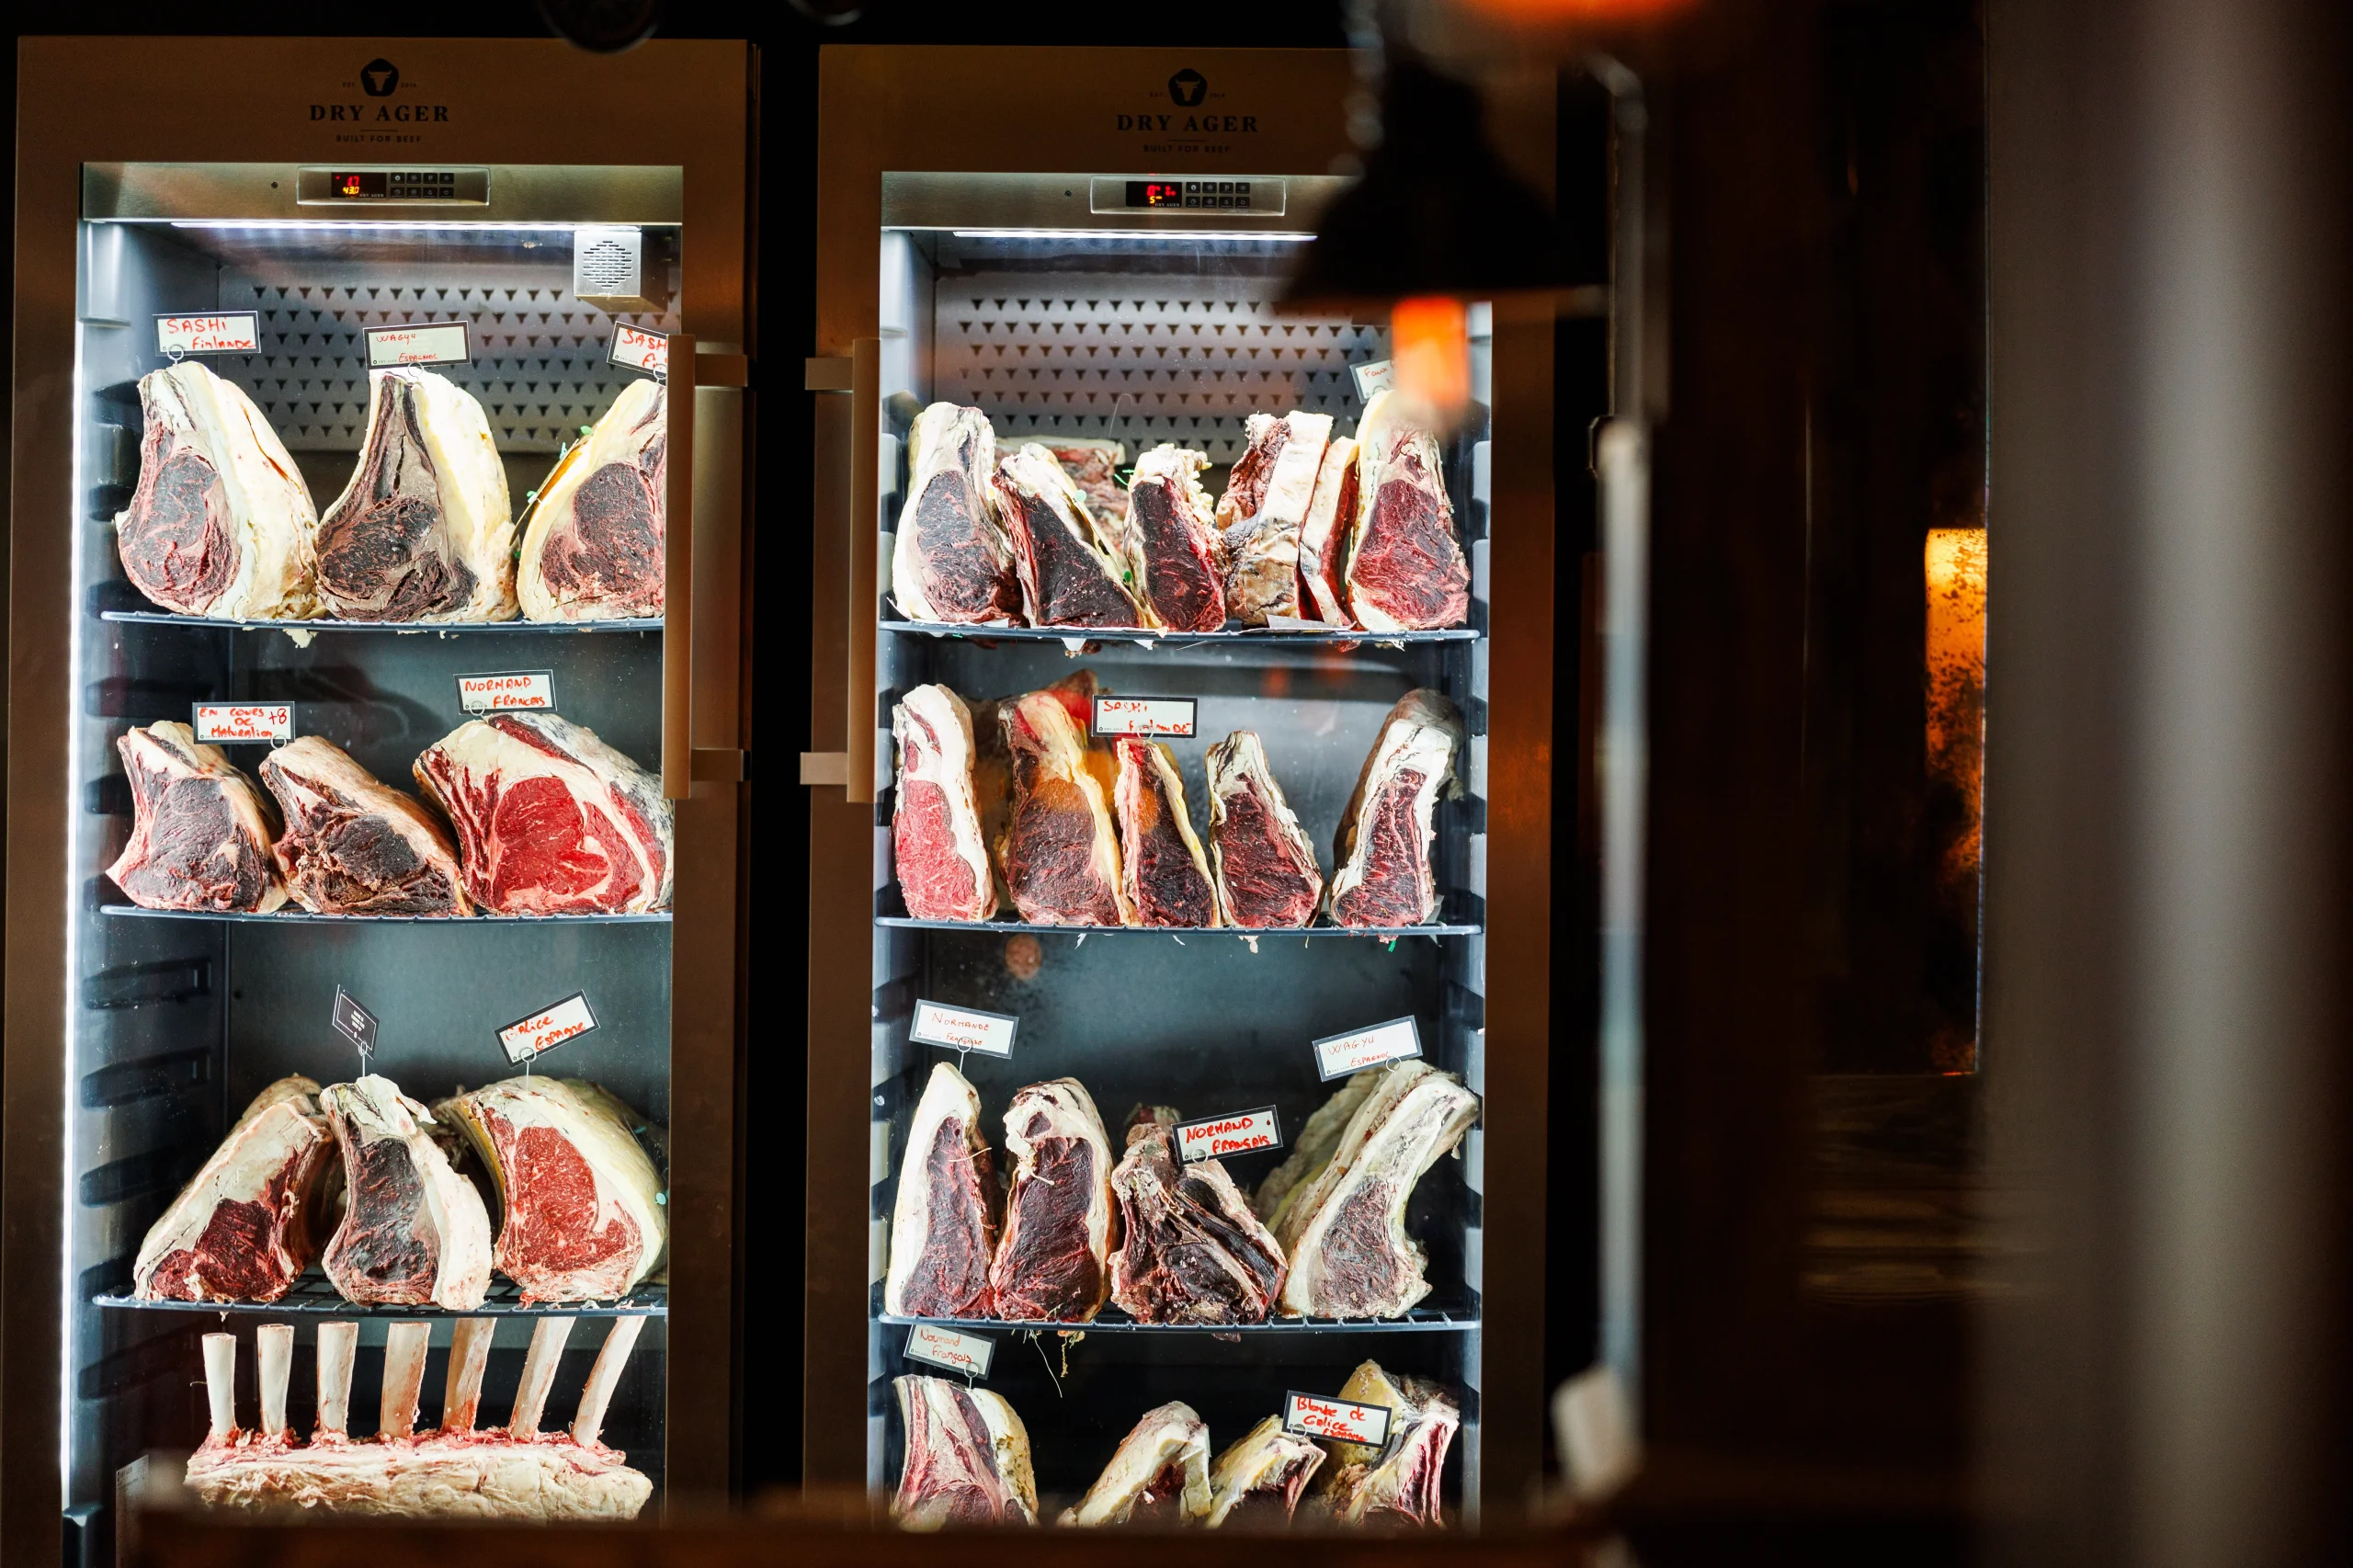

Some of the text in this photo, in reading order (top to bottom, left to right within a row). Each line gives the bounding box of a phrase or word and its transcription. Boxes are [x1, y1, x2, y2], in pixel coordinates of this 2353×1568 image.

[310, 105, 449, 122] DRY AGER
[1117, 114, 1258, 132] DRY AGER
[335, 134, 364, 142] BUILT
[396, 135, 422, 143] BEEF
[1143, 144, 1231, 153] BUILT FOR BEEF
[268, 708, 287, 725] +8
